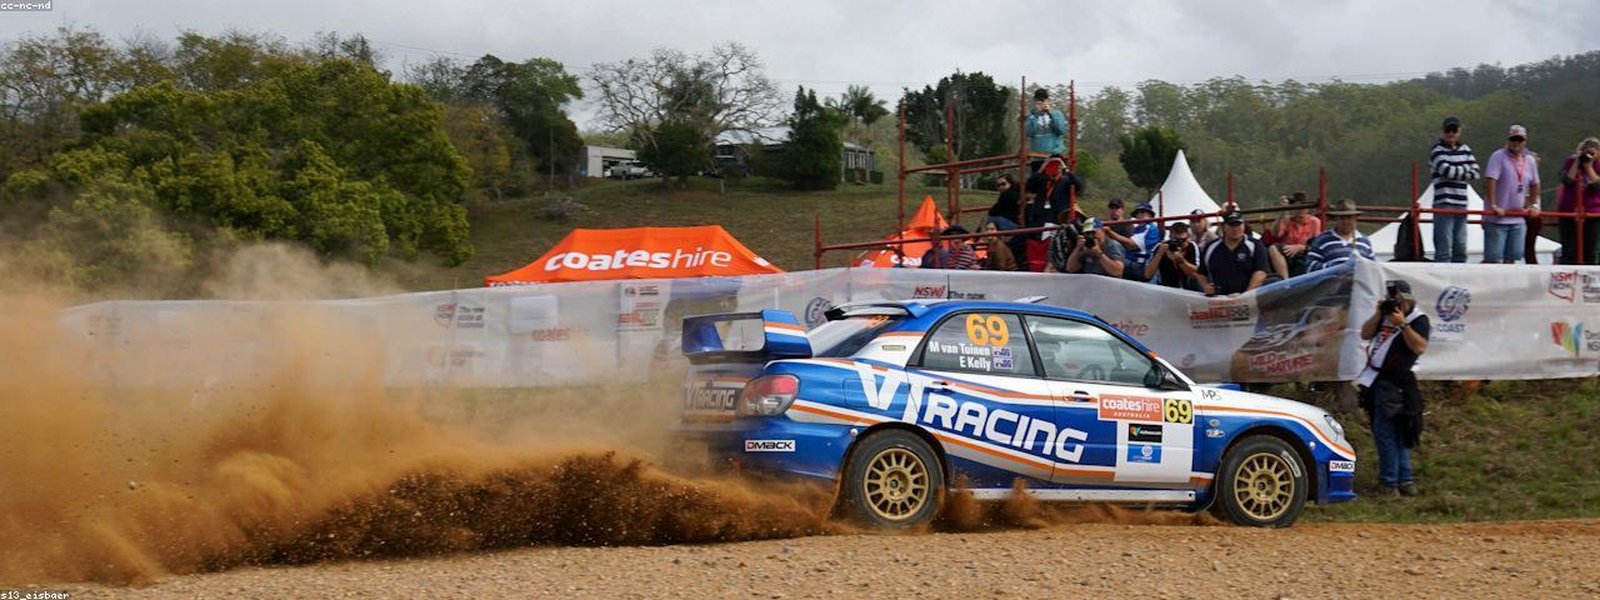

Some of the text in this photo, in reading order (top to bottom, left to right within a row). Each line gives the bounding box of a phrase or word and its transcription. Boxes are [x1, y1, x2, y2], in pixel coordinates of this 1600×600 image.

[965, 313, 1009, 346] 69
[929, 341, 939, 352] M
[941, 343, 958, 353] van
[960, 356, 991, 372] E Kelly
[1164, 399, 1193, 424] 69
